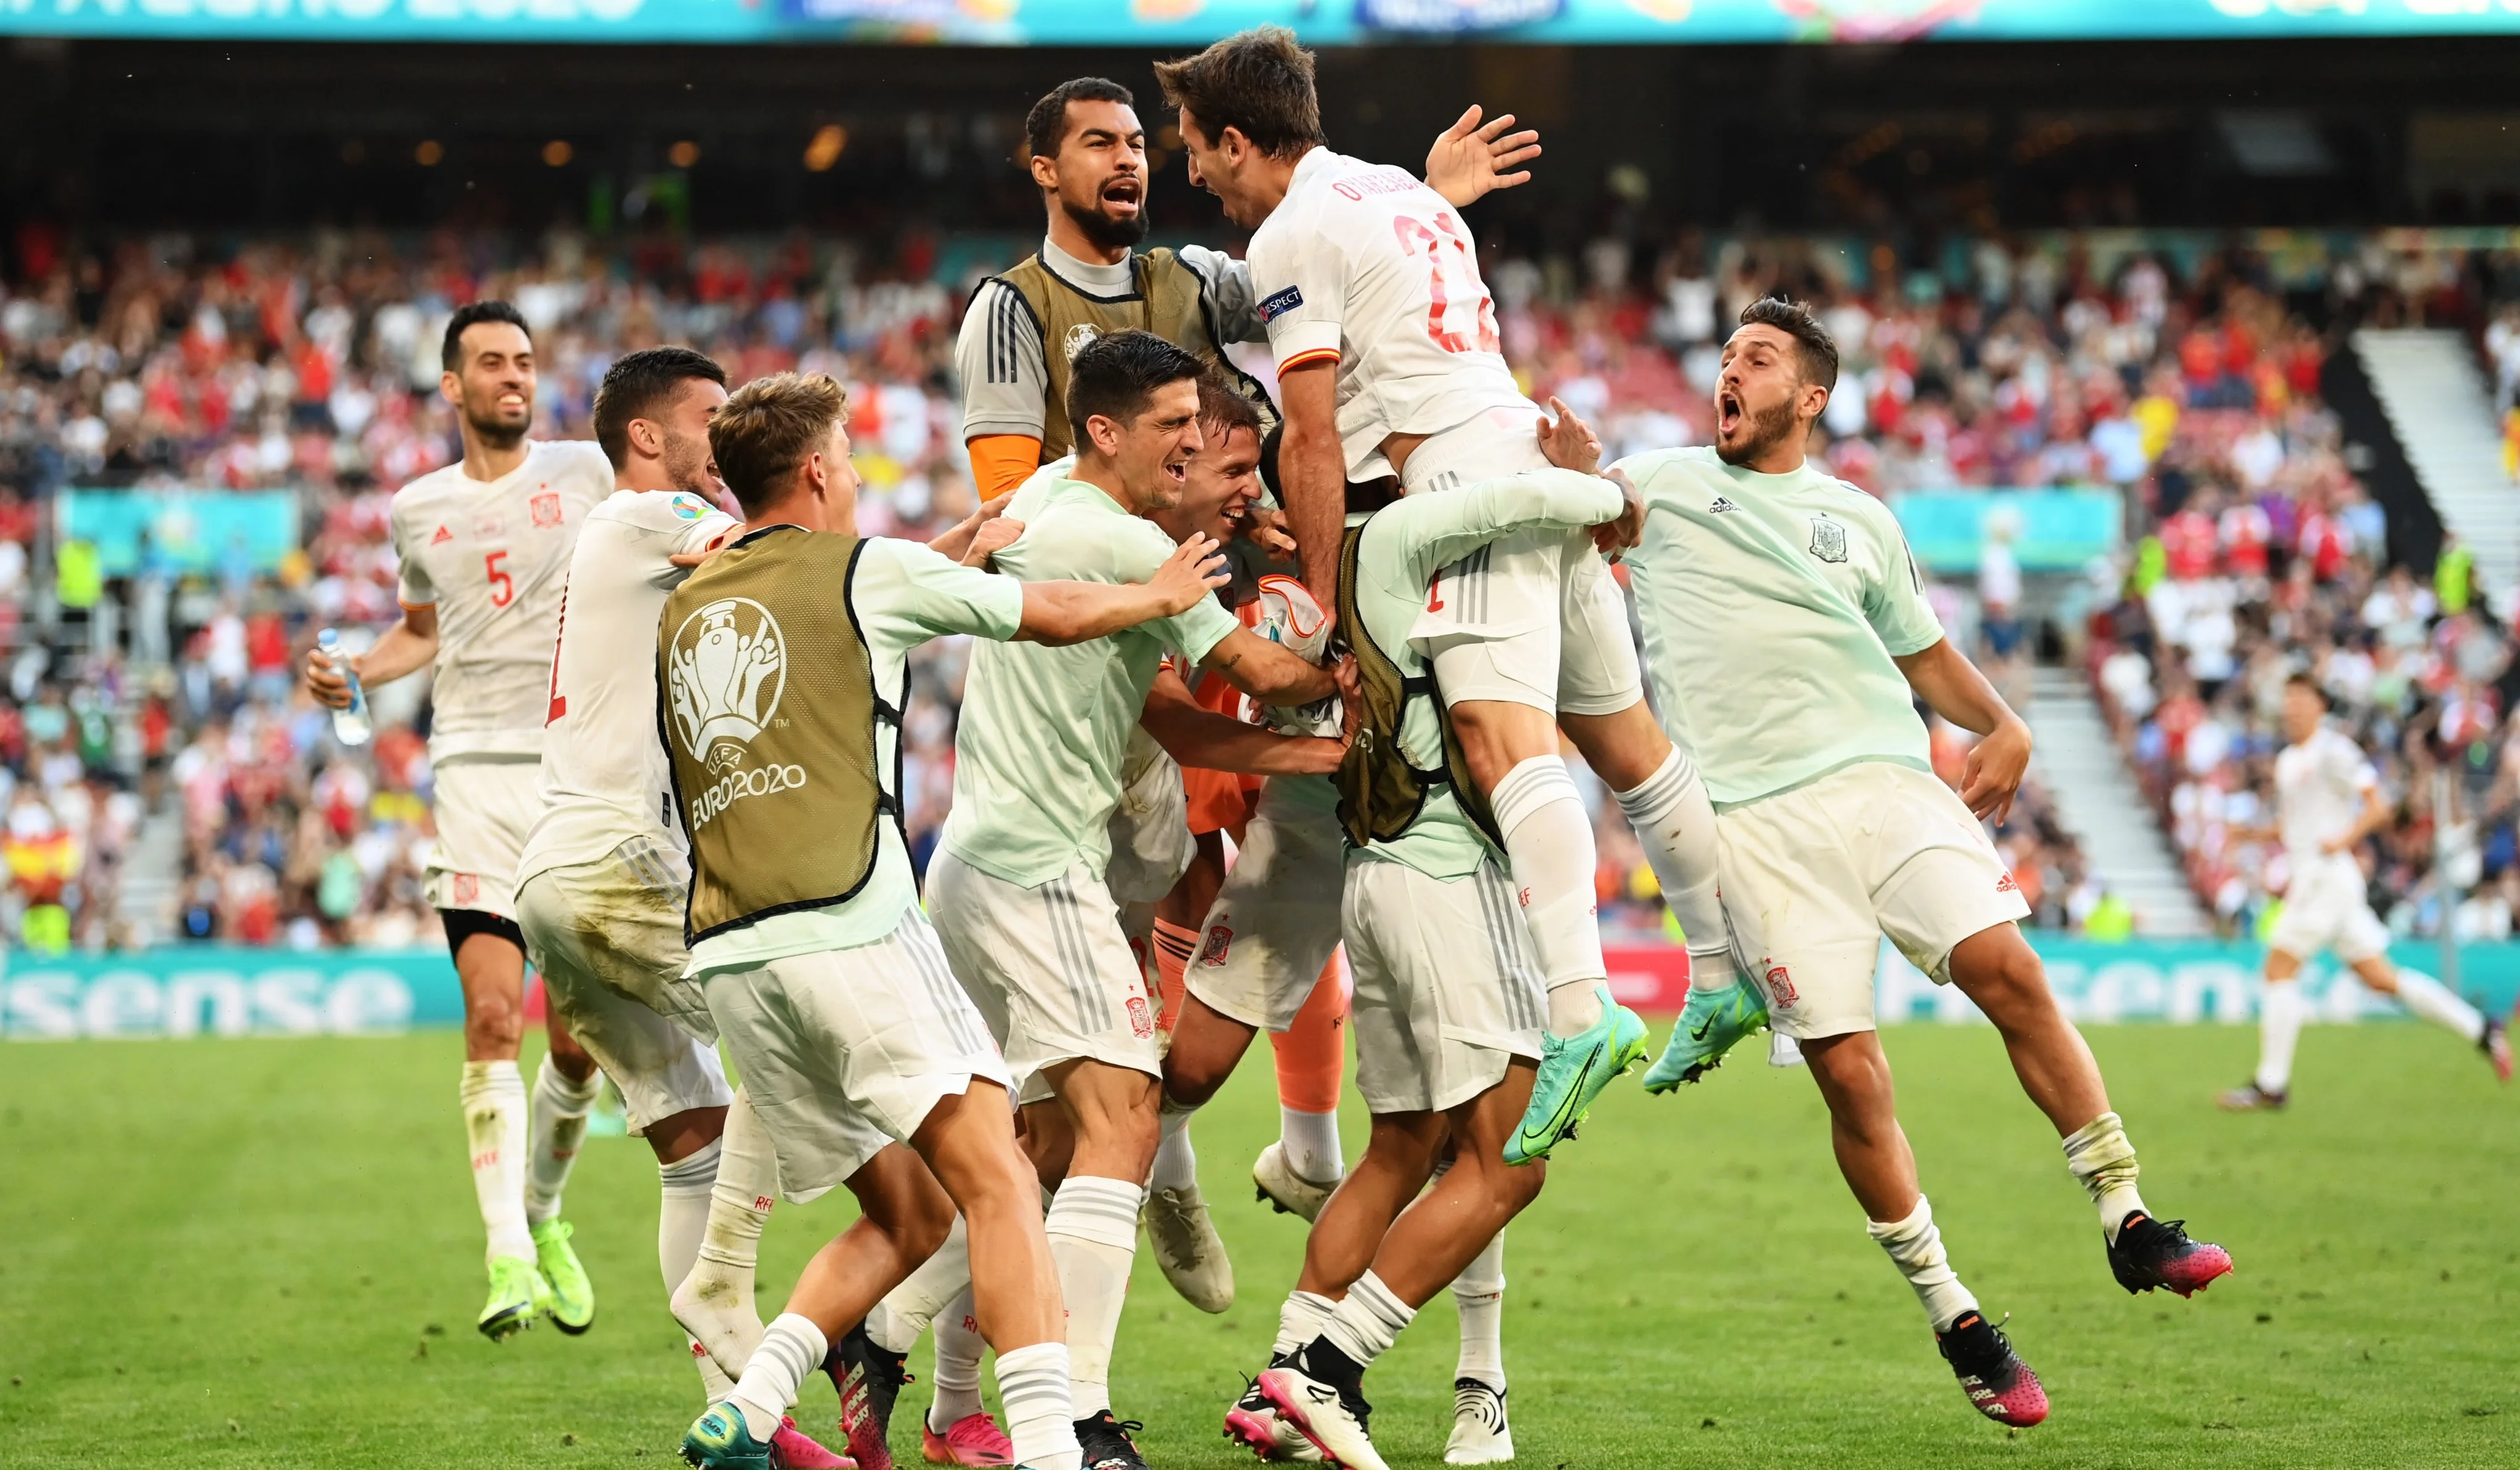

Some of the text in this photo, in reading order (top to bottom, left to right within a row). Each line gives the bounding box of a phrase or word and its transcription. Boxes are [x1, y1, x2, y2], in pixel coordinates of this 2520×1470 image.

[486, 550, 513, 607] 5
[709, 747, 741, 775] UEFA
[0, 969, 415, 1041] sense
